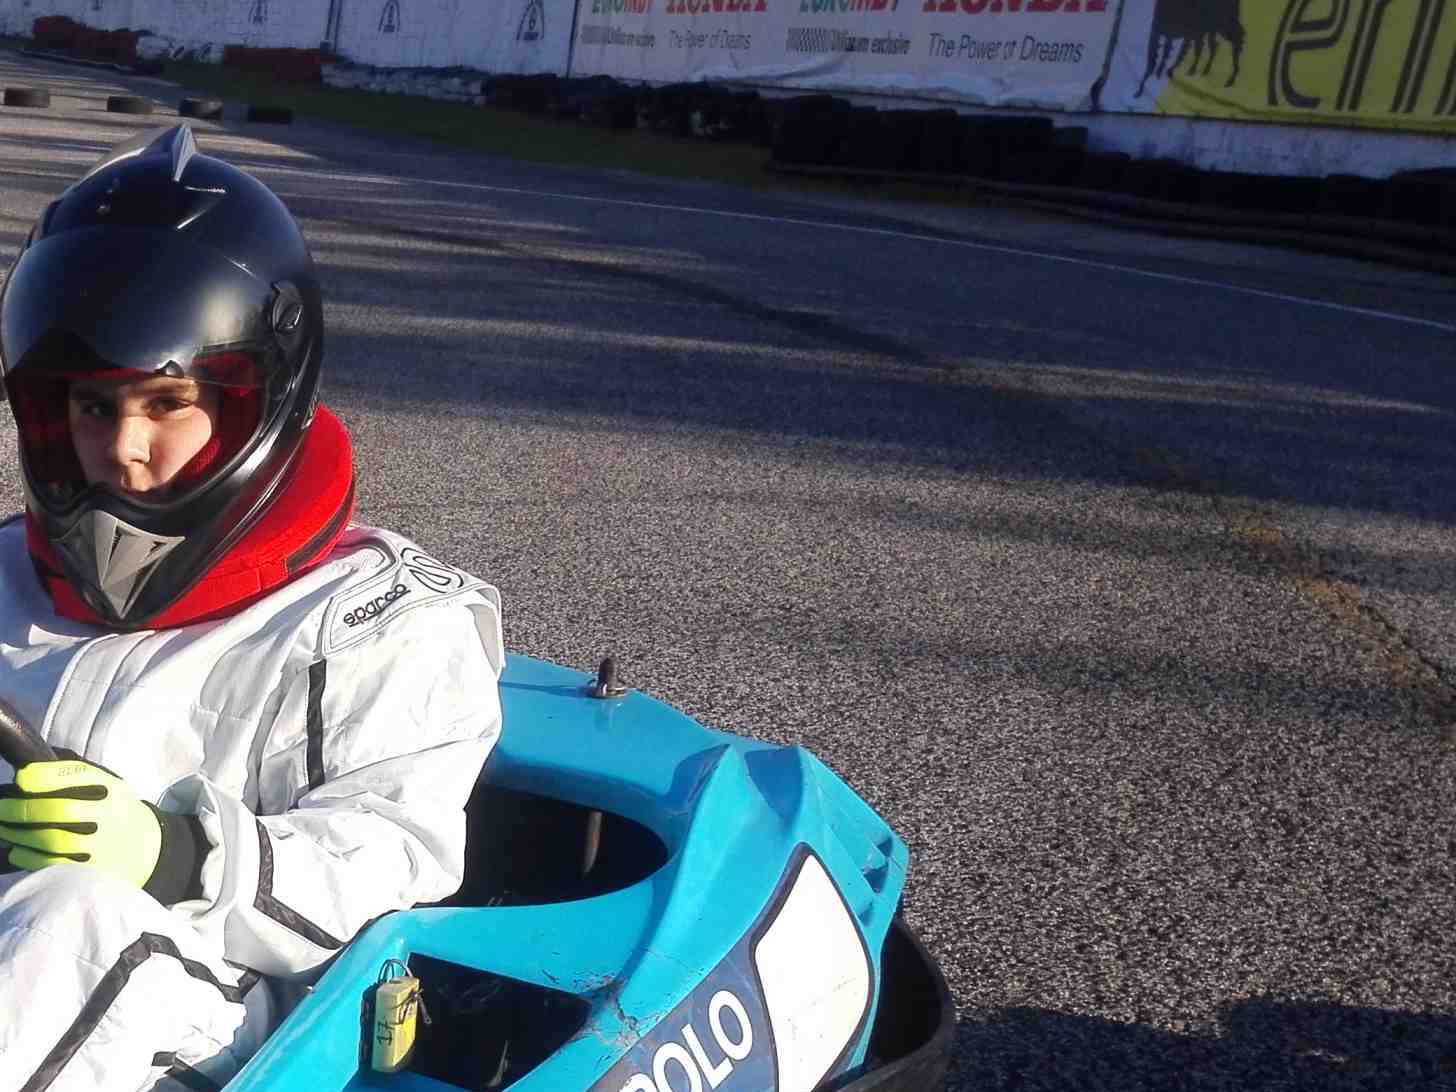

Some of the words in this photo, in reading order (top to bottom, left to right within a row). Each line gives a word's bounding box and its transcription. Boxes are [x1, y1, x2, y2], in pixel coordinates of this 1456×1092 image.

[928, 32, 955, 58] The
[958, 33, 1003, 61] Power
[1020, 35, 1085, 63] Dreams
[1265, 0, 1456, 114] en
[343, 583, 411, 627] sparco
